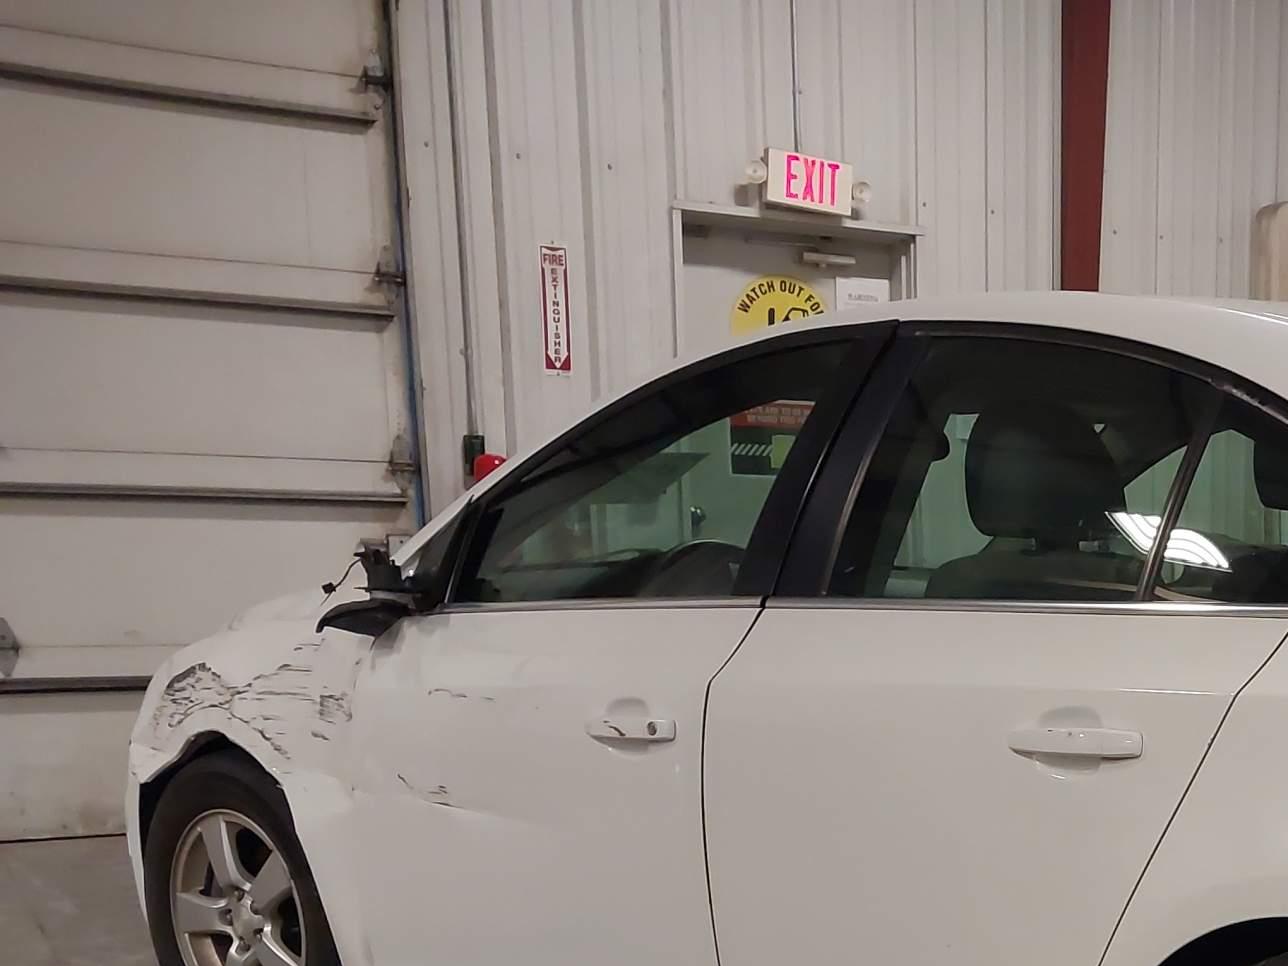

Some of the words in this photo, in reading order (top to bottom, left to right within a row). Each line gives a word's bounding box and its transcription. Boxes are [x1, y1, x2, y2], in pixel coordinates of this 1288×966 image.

[785, 154, 840, 206] EXIT
[543, 253, 565, 267] FIRE
[551, 268, 562, 363] EXTINGUISHER
[737, 280, 776, 313] WATCH
[780, 280, 805, 298] OUT
